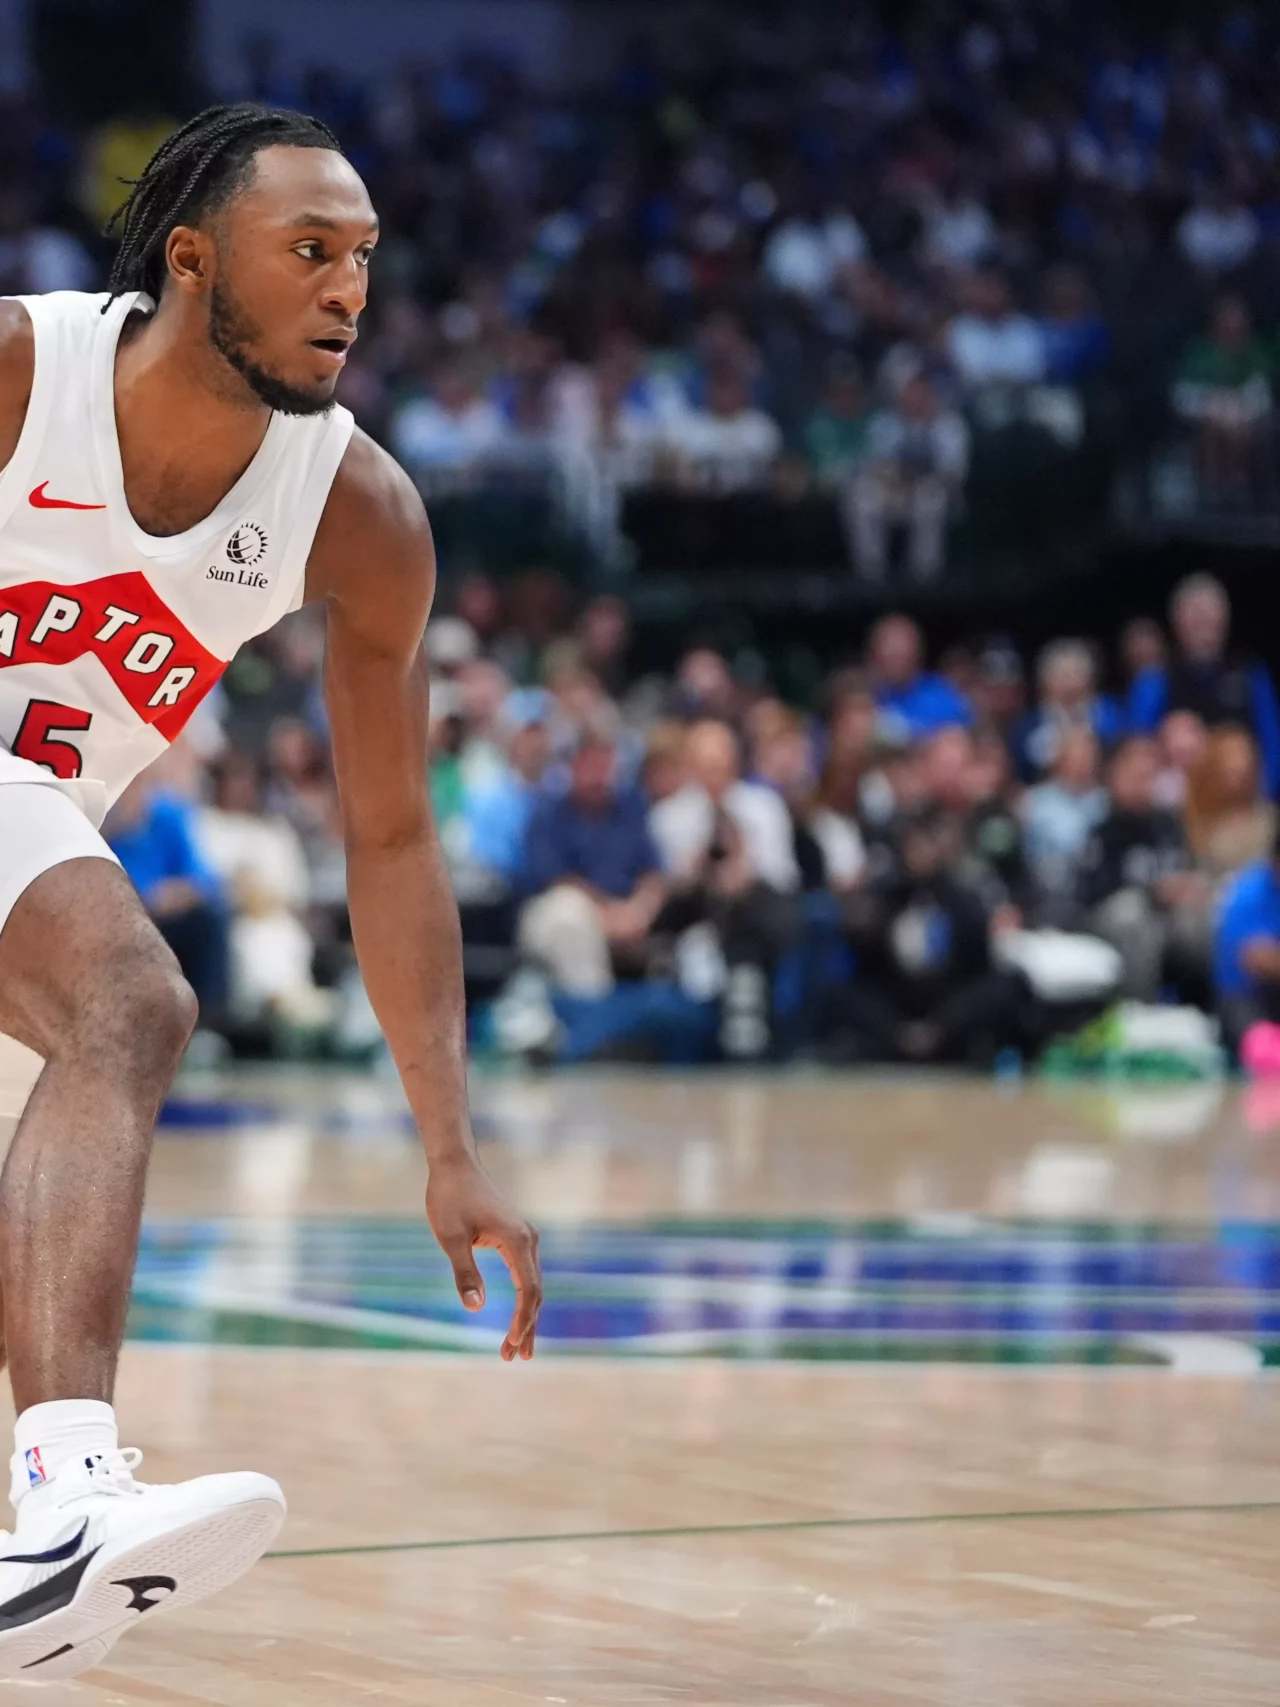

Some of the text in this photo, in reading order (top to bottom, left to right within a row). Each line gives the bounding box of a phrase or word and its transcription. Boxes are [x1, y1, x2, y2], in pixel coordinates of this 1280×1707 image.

[206, 565, 269, 589] Sun Life
[11, 698, 93, 779] 5
